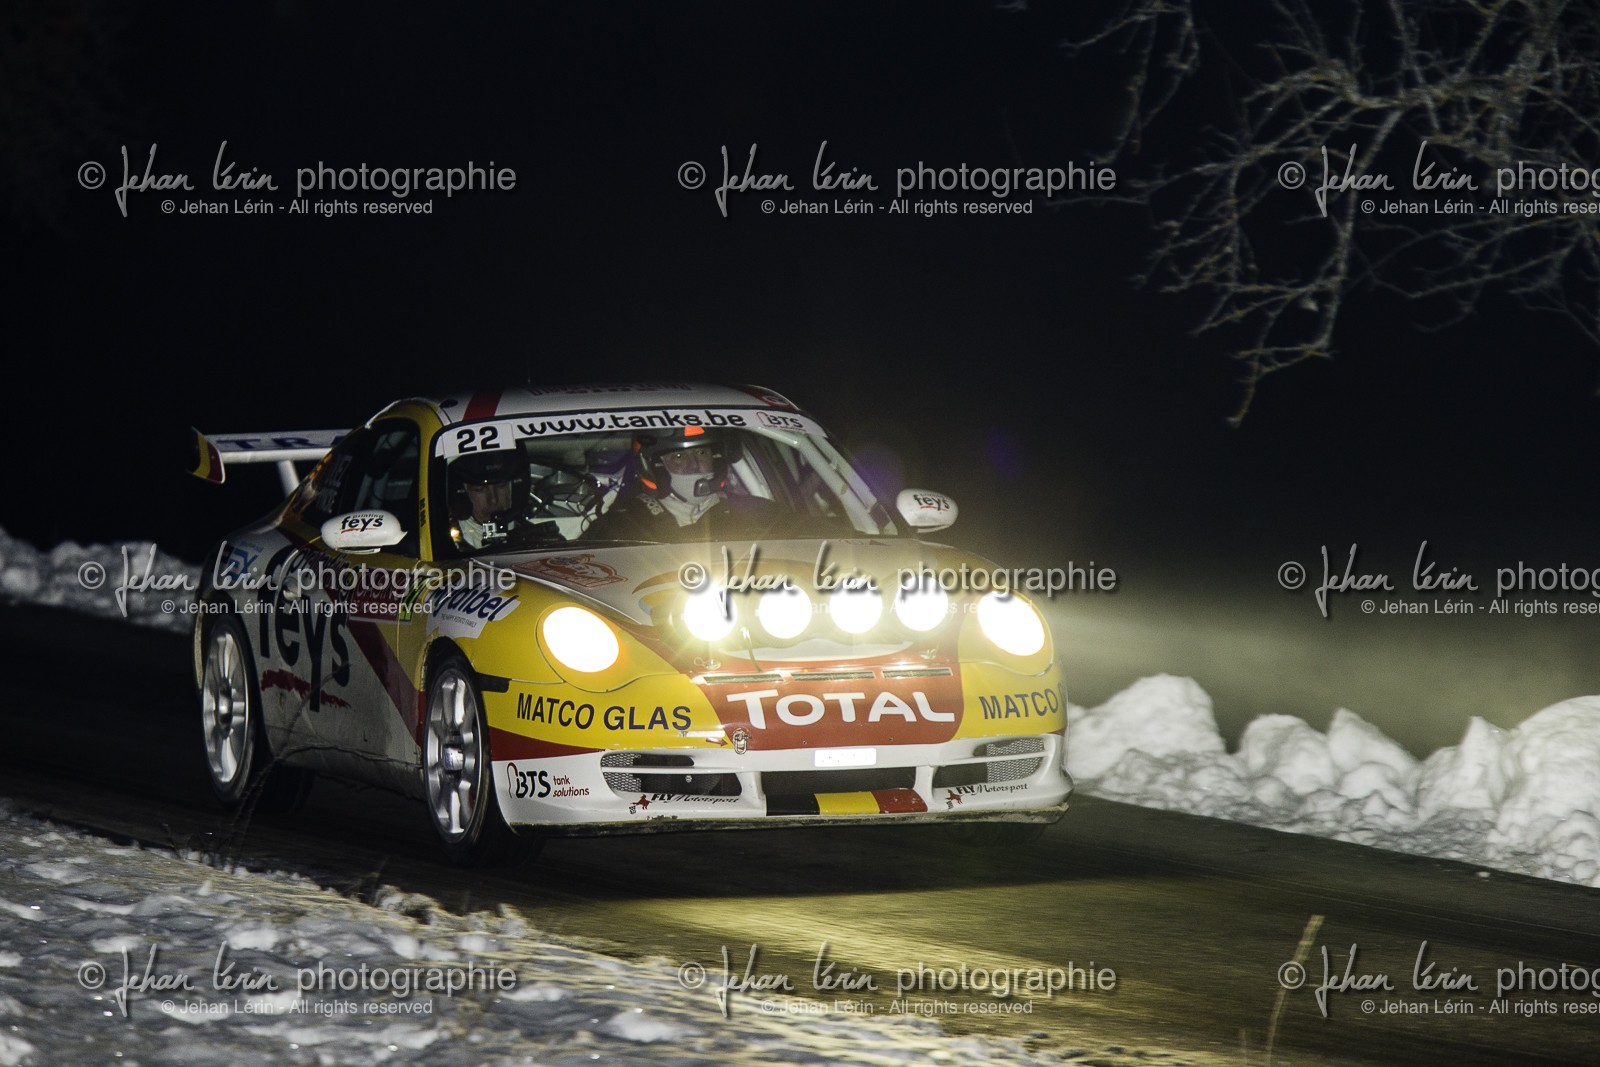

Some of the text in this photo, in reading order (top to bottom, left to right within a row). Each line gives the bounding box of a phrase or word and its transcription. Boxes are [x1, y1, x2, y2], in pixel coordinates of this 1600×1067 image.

[517, 409, 747, 436] www.tanks.be
[767, 415, 804, 428] BTS
[456, 424, 501, 454] 22
[913, 494, 950, 511] feys
[341, 516, 383, 532] feys
[517, 692, 692, 730] MATCO GLAS
[727, 689, 955, 730] TOTAL
[979, 688, 1059, 719] MATCO
[516, 770, 551, 798] BTS
[553, 775, 571, 785] tank
[553, 786, 590, 797] solutions
[956, 783, 1028, 795] FLY Motorsport
[651, 793, 739, 803] FLY Motorsport
